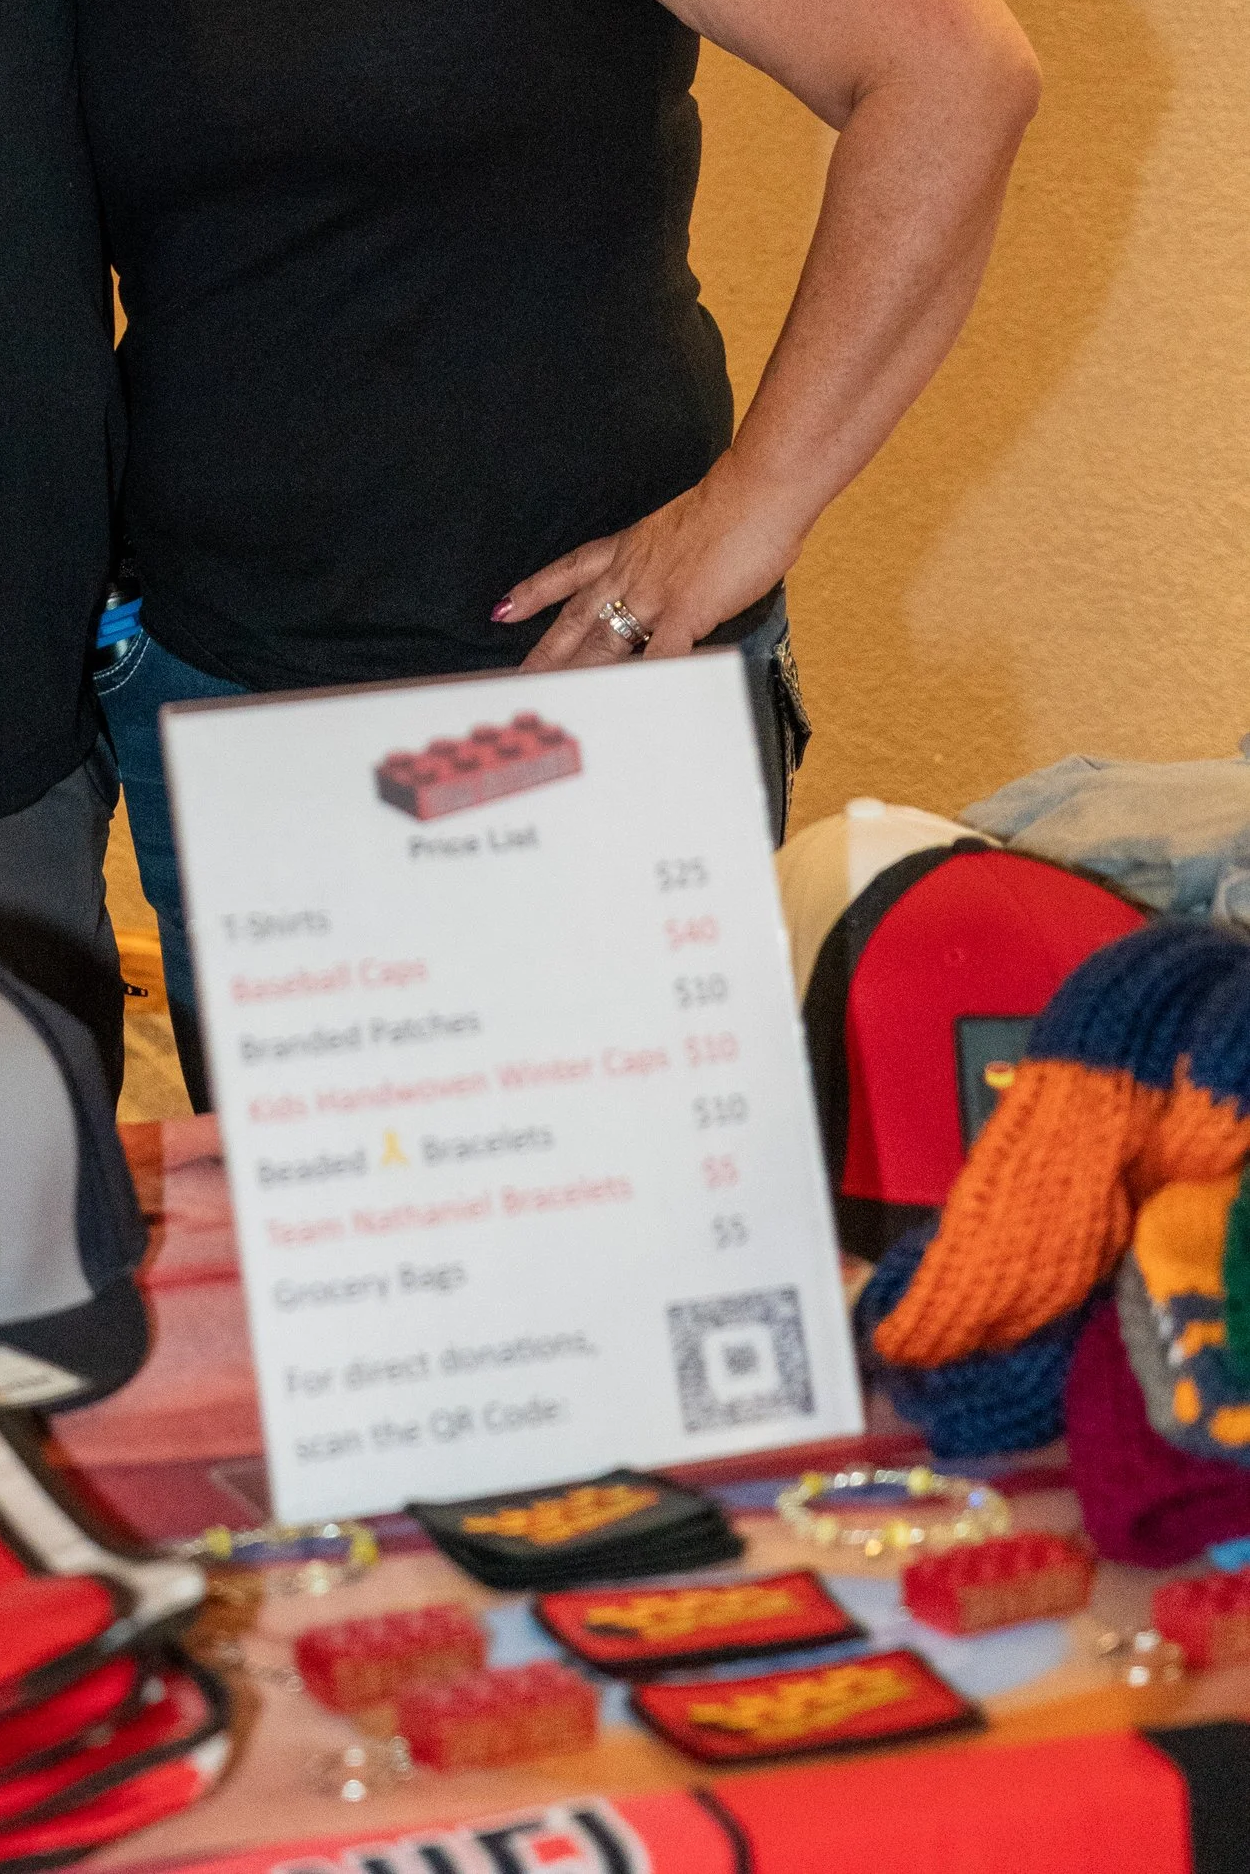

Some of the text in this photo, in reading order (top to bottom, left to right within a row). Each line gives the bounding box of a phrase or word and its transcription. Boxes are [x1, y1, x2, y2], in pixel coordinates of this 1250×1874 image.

[407, 825, 540, 863] Price List
[655, 858, 710, 893] $25
[231, 916, 719, 1005] Baseball Caps $40
[240, 975, 729, 1066] Branded Patches $10
[248, 1093, 308, 1125] Kids
[497, 1057, 595, 1090] Winter
[603, 1048, 671, 1079] Caps
[685, 1034, 739, 1068] $10
[257, 1094, 748, 1190] Beaded Bracelets $10
[268, 1158, 739, 1247] Team Nathaniel Bracelets $5
[274, 1215, 748, 1310] Grocery Bags $5
[286, 1366, 335, 1398] For
[344, 1350, 430, 1389] direct
[295, 1430, 362, 1462] scan
[370, 1420, 421, 1449] the
[429, 1406, 475, 1443] QR
